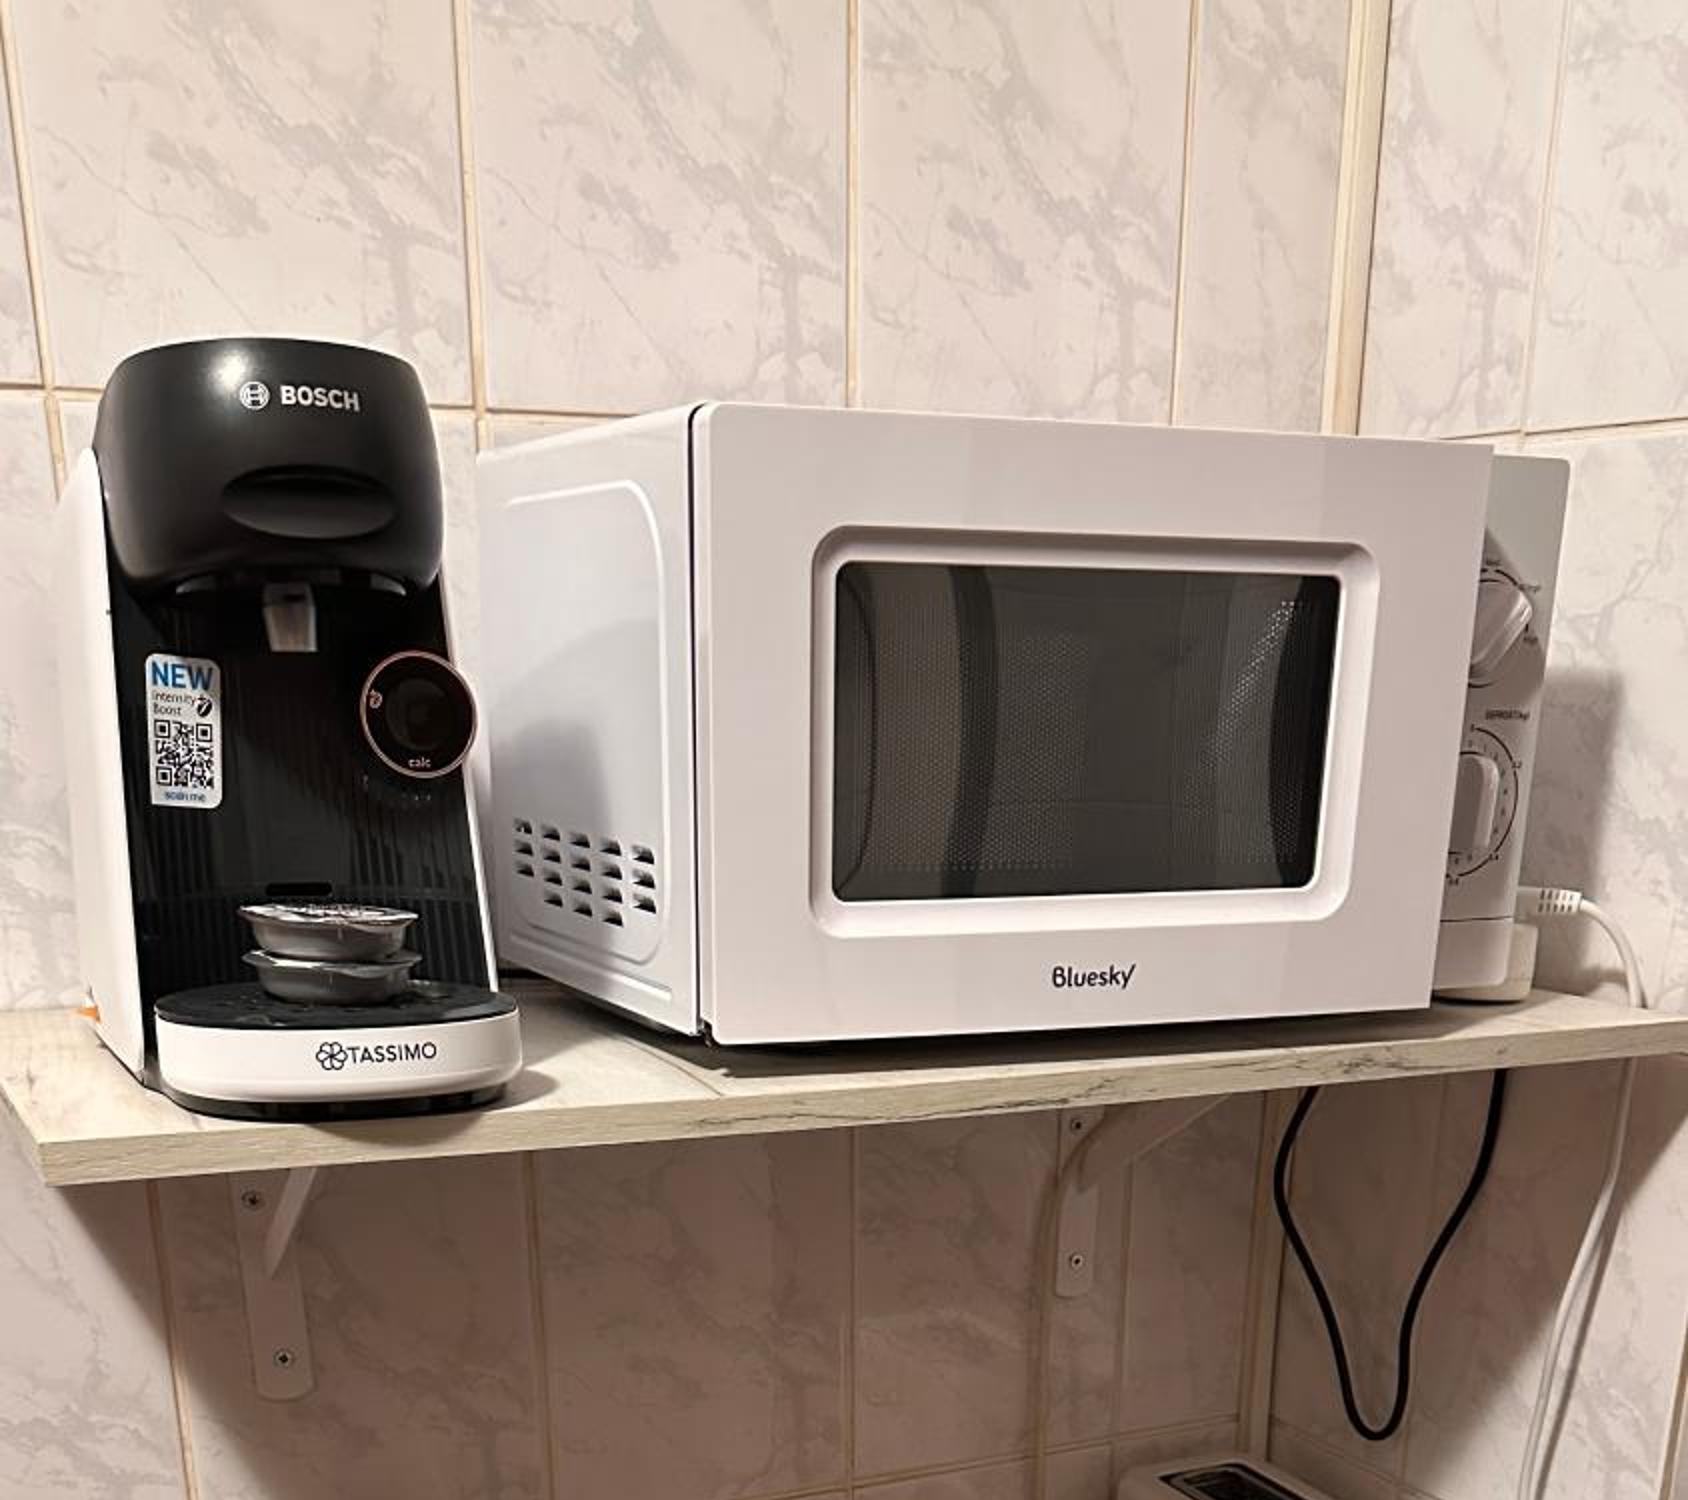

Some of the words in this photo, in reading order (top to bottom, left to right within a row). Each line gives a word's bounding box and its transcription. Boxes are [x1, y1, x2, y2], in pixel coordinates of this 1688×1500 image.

[280, 384, 360, 412] BOSCH
[151, 661, 213, 691] NEW
[153, 702, 182, 716] Boost
[408, 757, 432, 768] calc
[1051, 963, 1137, 990] Bluesky
[347, 1041, 437, 1064] TASSIMO
